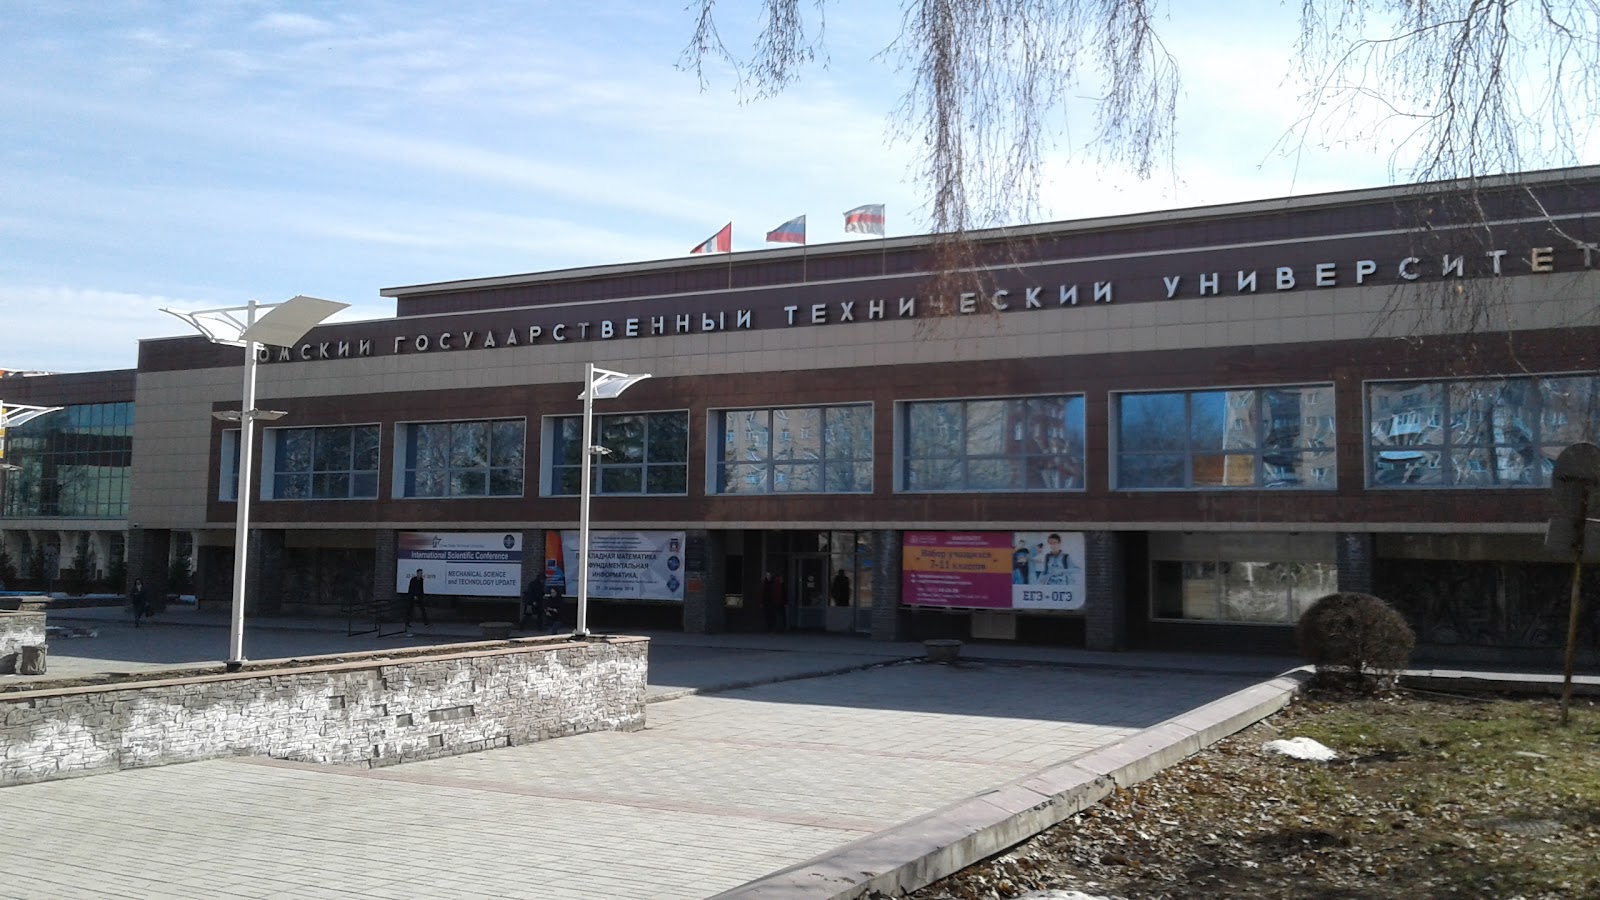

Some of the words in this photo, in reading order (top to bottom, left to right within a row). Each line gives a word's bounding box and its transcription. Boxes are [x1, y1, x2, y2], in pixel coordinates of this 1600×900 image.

[258, 339, 370, 363] ОМСКИЙ
[394, 309, 752, 353] ГОСУДАРСТВЕННЫЙ
[784, 281, 1113, 325] ТЕХНИЧЕСКИЙ
[1162, 242, 1599, 299] УНИВЕРСИТЕТ
[411, 551, 446, 559] International
[447, 551, 474, 559] Scientific
[475, 552, 509, 560] Conference
[929, 560, 949, 569] 7-11
[1023, 590, 1043, 601] ЕГЭ
[1051, 591, 1072, 602] ОГЭ
